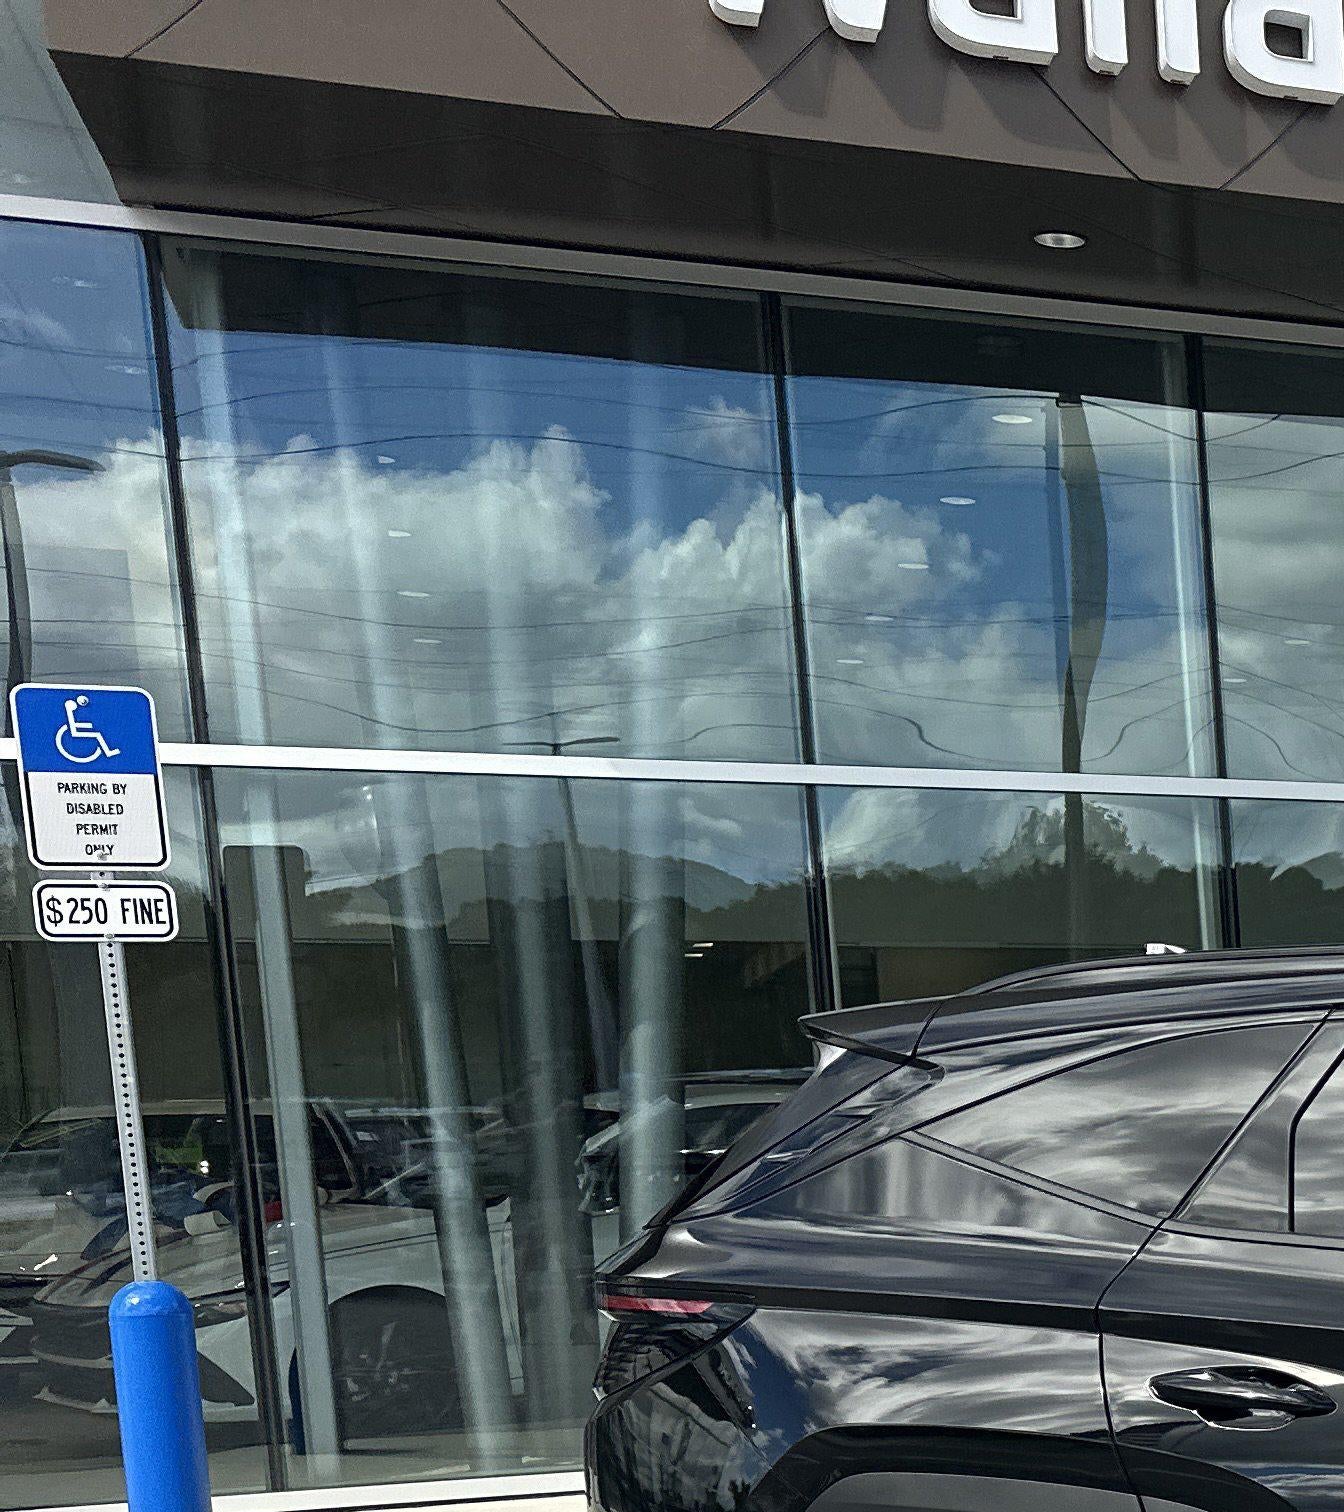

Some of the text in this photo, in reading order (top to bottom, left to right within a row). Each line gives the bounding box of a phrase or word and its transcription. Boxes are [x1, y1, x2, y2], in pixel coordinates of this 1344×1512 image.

[57, 782, 128, 795] PARKING BY
[66, 803, 124, 815] DISABLED
[76, 823, 118, 836] PERMIT
[85, 844, 115, 856] ONLY
[46, 895, 166, 927] $250 FINE
